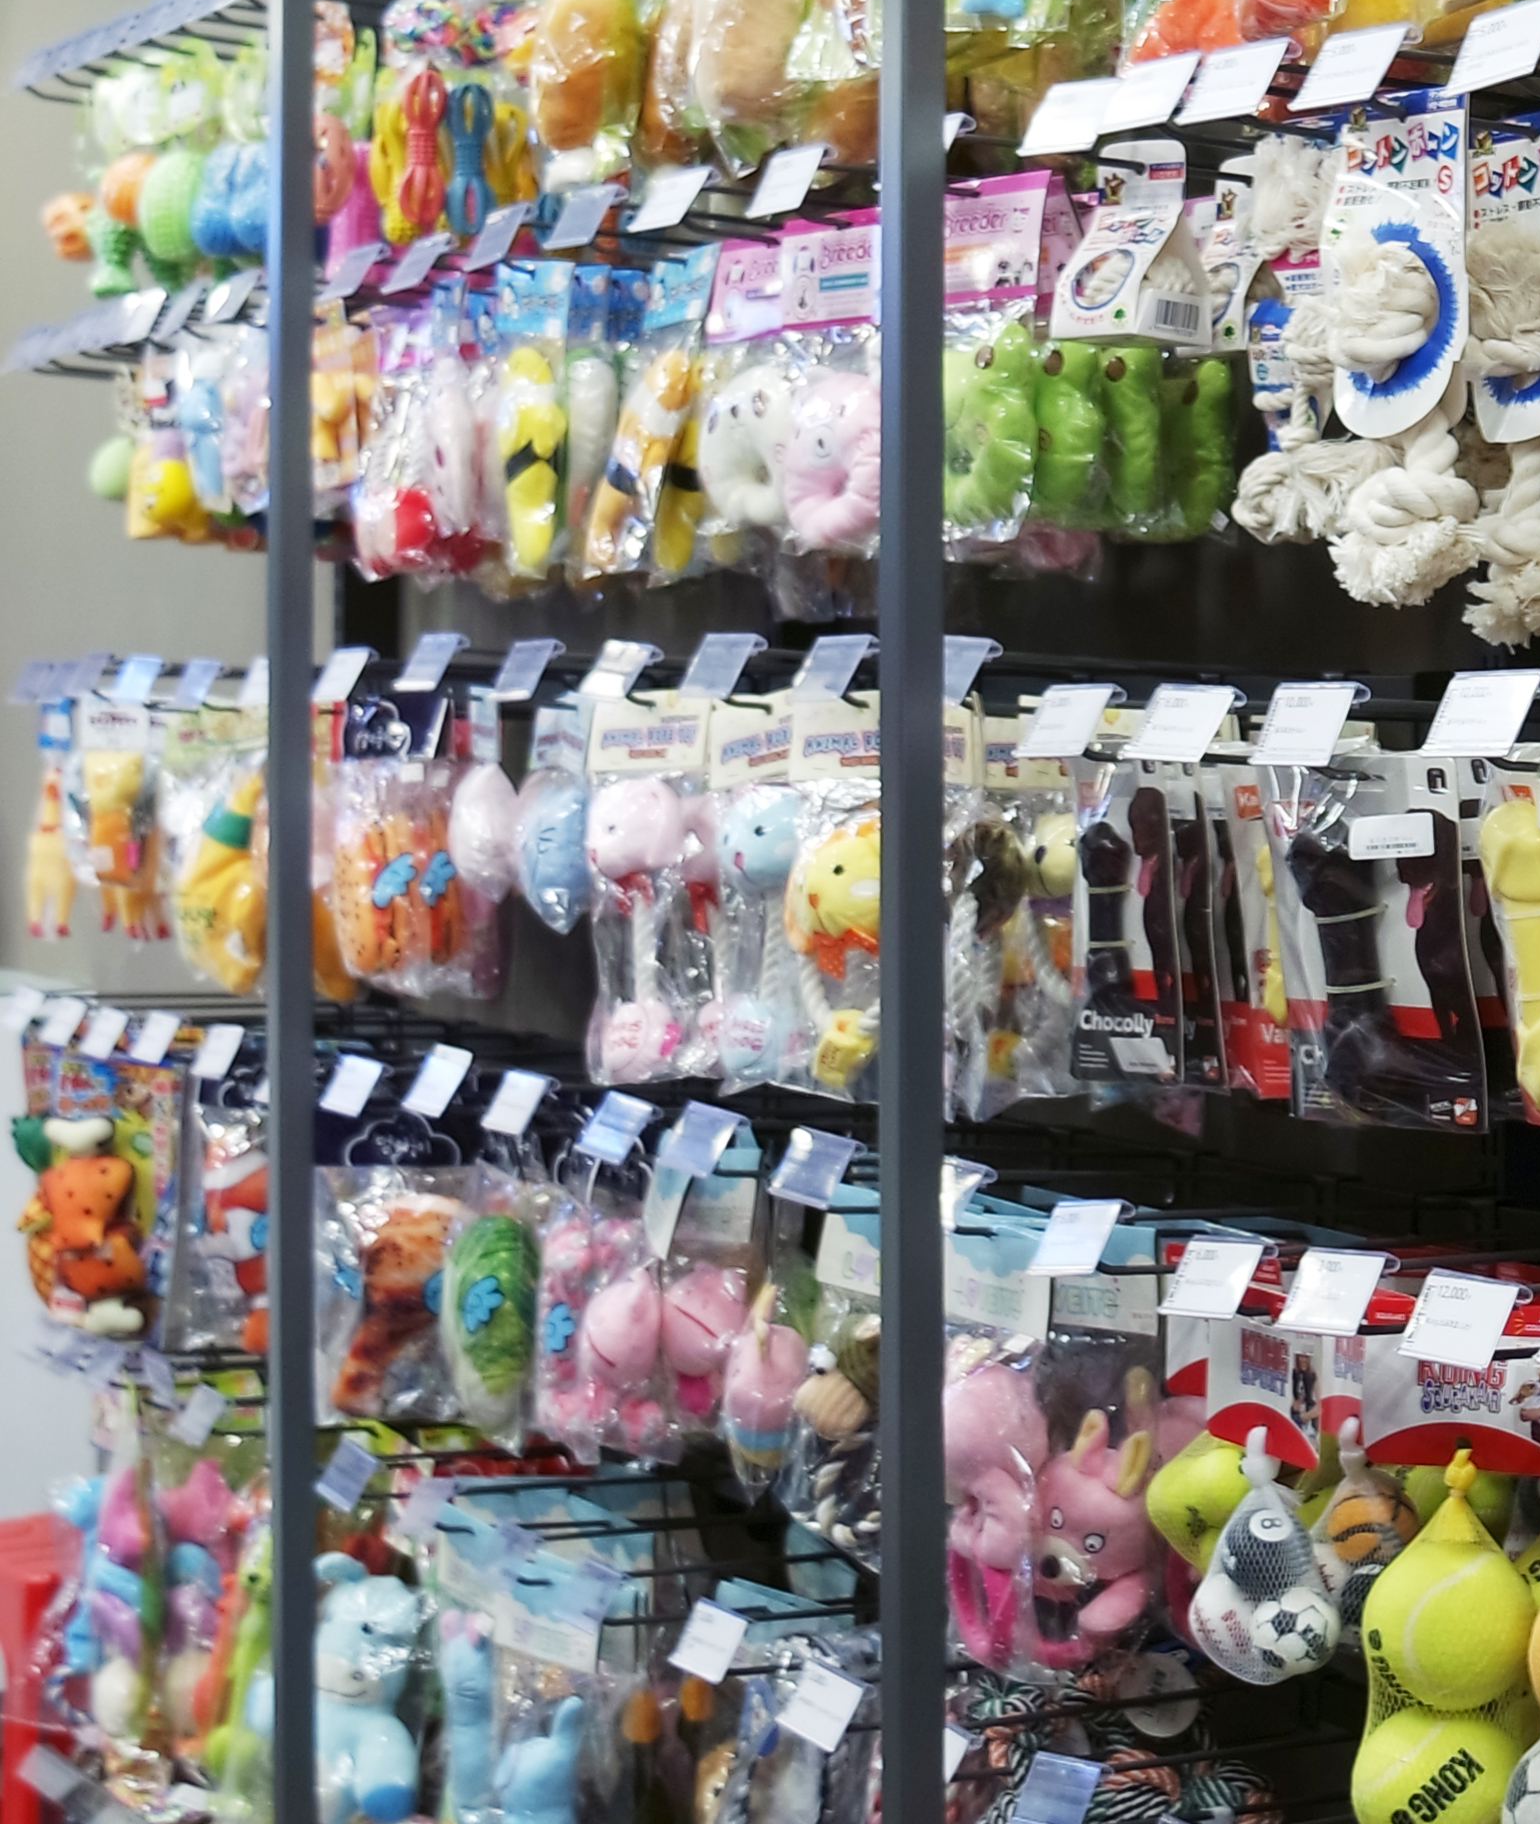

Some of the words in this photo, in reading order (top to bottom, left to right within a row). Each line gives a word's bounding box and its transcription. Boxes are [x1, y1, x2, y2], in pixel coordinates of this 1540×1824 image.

[1437, 170, 1453, 189] S
[820, 234, 874, 271] Breede
[1079, 1010, 1155, 1039] Chocolly
[1408, 1747, 1486, 1824] KONG
